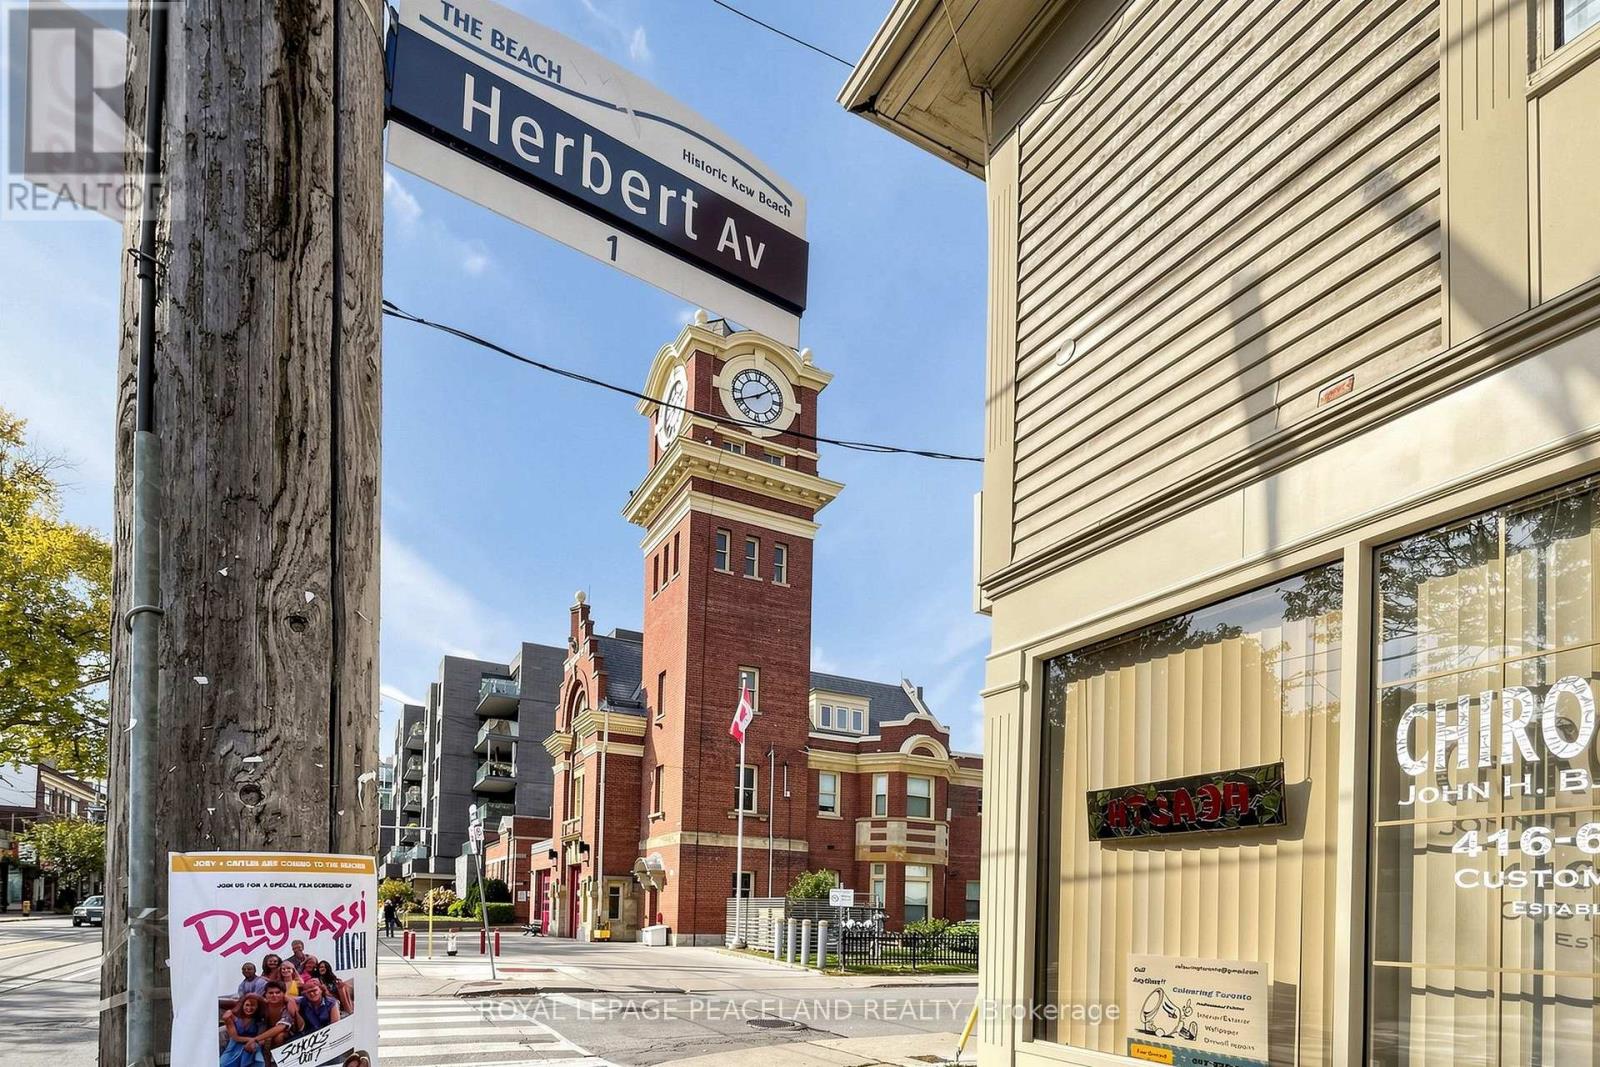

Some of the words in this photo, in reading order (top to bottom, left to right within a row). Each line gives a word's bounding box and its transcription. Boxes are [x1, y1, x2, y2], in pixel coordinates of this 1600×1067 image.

[441, 0, 483, 41] THE
[490, 28, 562, 84] BEACH
[462, 73, 699, 241] Herbert
[716, 217, 766, 270] Av
[682, 148, 727, 183] Historic
[731, 175, 755, 198] Kew
[759, 191, 791, 218] Beach
[606, 235, 618, 262] 1
[1398, 781, 1490, 806] JOHN
[1503, 772, 1544, 797] H.
[1559, 767, 1600, 791] B
[1451, 822, 1600, 857] 416-6
[314, 861, 325, 869] TO
[1215, 990, 1252, 1001] Toronto
